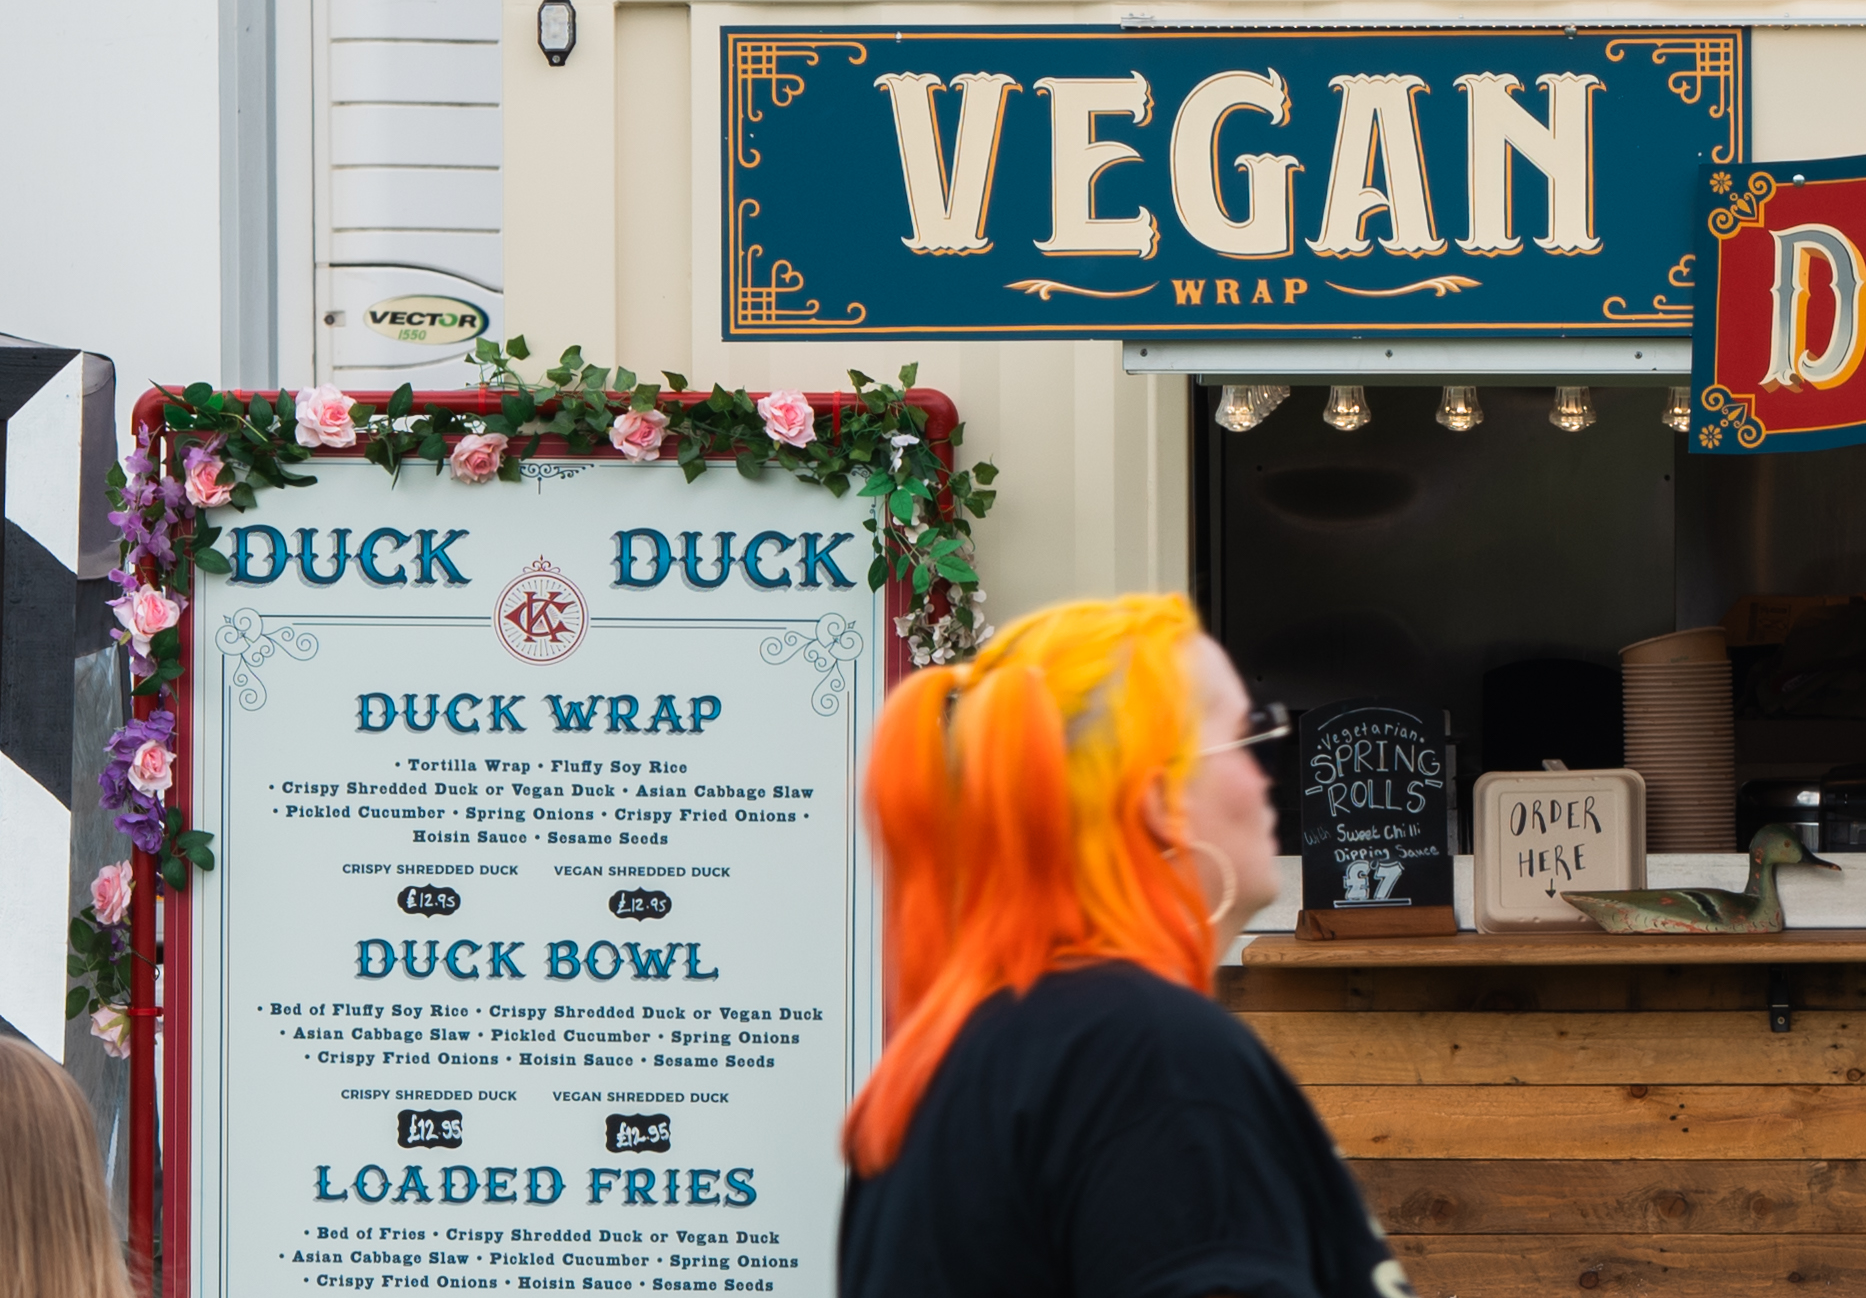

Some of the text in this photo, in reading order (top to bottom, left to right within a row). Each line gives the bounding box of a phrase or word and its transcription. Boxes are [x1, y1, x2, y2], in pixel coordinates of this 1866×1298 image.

[873, 67, 1607, 259] VEGAN
[1171, 278, 1309, 306] WRAP
[369, 311, 477, 328] VECTOR
[226, 525, 857, 590] DUCK DUCK
[356, 692, 721, 734] DUCK WRAP
[1320, 722, 1419, 750] Vegetarian
[408, 759, 687, 776] Tortilla Wrap Fluffy Soy Rice
[1310, 739, 1441, 784] SPRING
[282, 781, 814, 801] Crispy Shredded Duck or Vegan Duck Asian Cabbage Slaw
[1327, 779, 1426, 817] ROLLS
[1510, 796, 1602, 836] ORDER
[1336, 823, 1380, 842] Sweet
[1383, 823, 1421, 840] Chilli
[1334, 844, 1439, 863] Dipping Sauce
[1518, 843, 1586, 881] HERE
[342, 864, 518, 875] CRISPY SHREDDED DUCK
[554, 866, 730, 877] VEGAN SHREDDED DUCK
[1343, 860, 1405, 900] £7
[404, 890, 667, 914] £12.95 £12.95
[356, 939, 719, 981] DUCK BOWL
[407, 1115, 461, 1143] £12.95
[315, 1164, 757, 1208] LOADED FRIES
